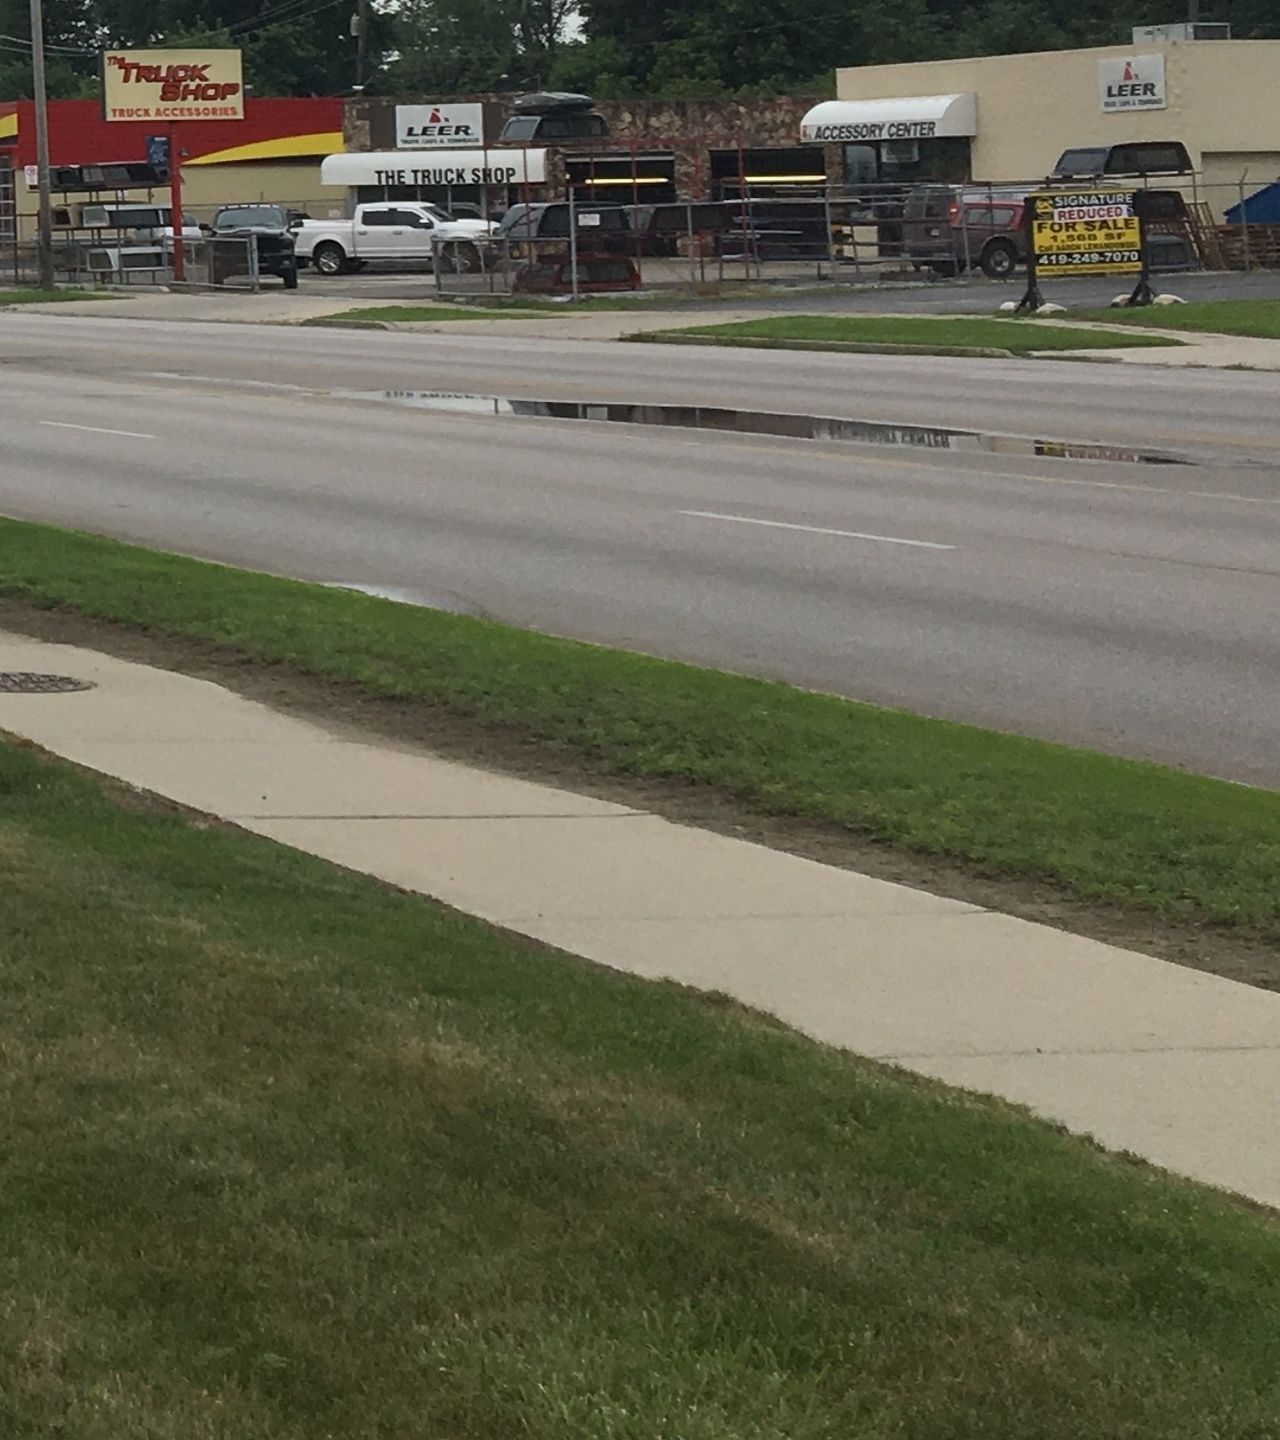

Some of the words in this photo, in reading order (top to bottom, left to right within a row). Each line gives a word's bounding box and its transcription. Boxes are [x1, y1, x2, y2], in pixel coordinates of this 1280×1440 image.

[1107, 83, 1156, 97] LEER
[111, 108, 150, 117] TRUCK
[155, 106, 237, 117] ACCESSORIES
[406, 125, 471, 137] LEER
[814, 123, 886, 140] ACCESSORY
[887, 121, 937, 138] CENTER
[375, 170, 406, 185] THE
[411, 168, 466, 184] TRUCK
[471, 167, 516, 183] SHOP
[1054, 194, 1133, 207] SIGNATURE
[1058, 206, 1123, 220] REDUCED
[1037, 221, 1078, 233] FOR
[1085, 218, 1136, 231] SALE
[1039, 251, 1139, 264] 419-249-7070
